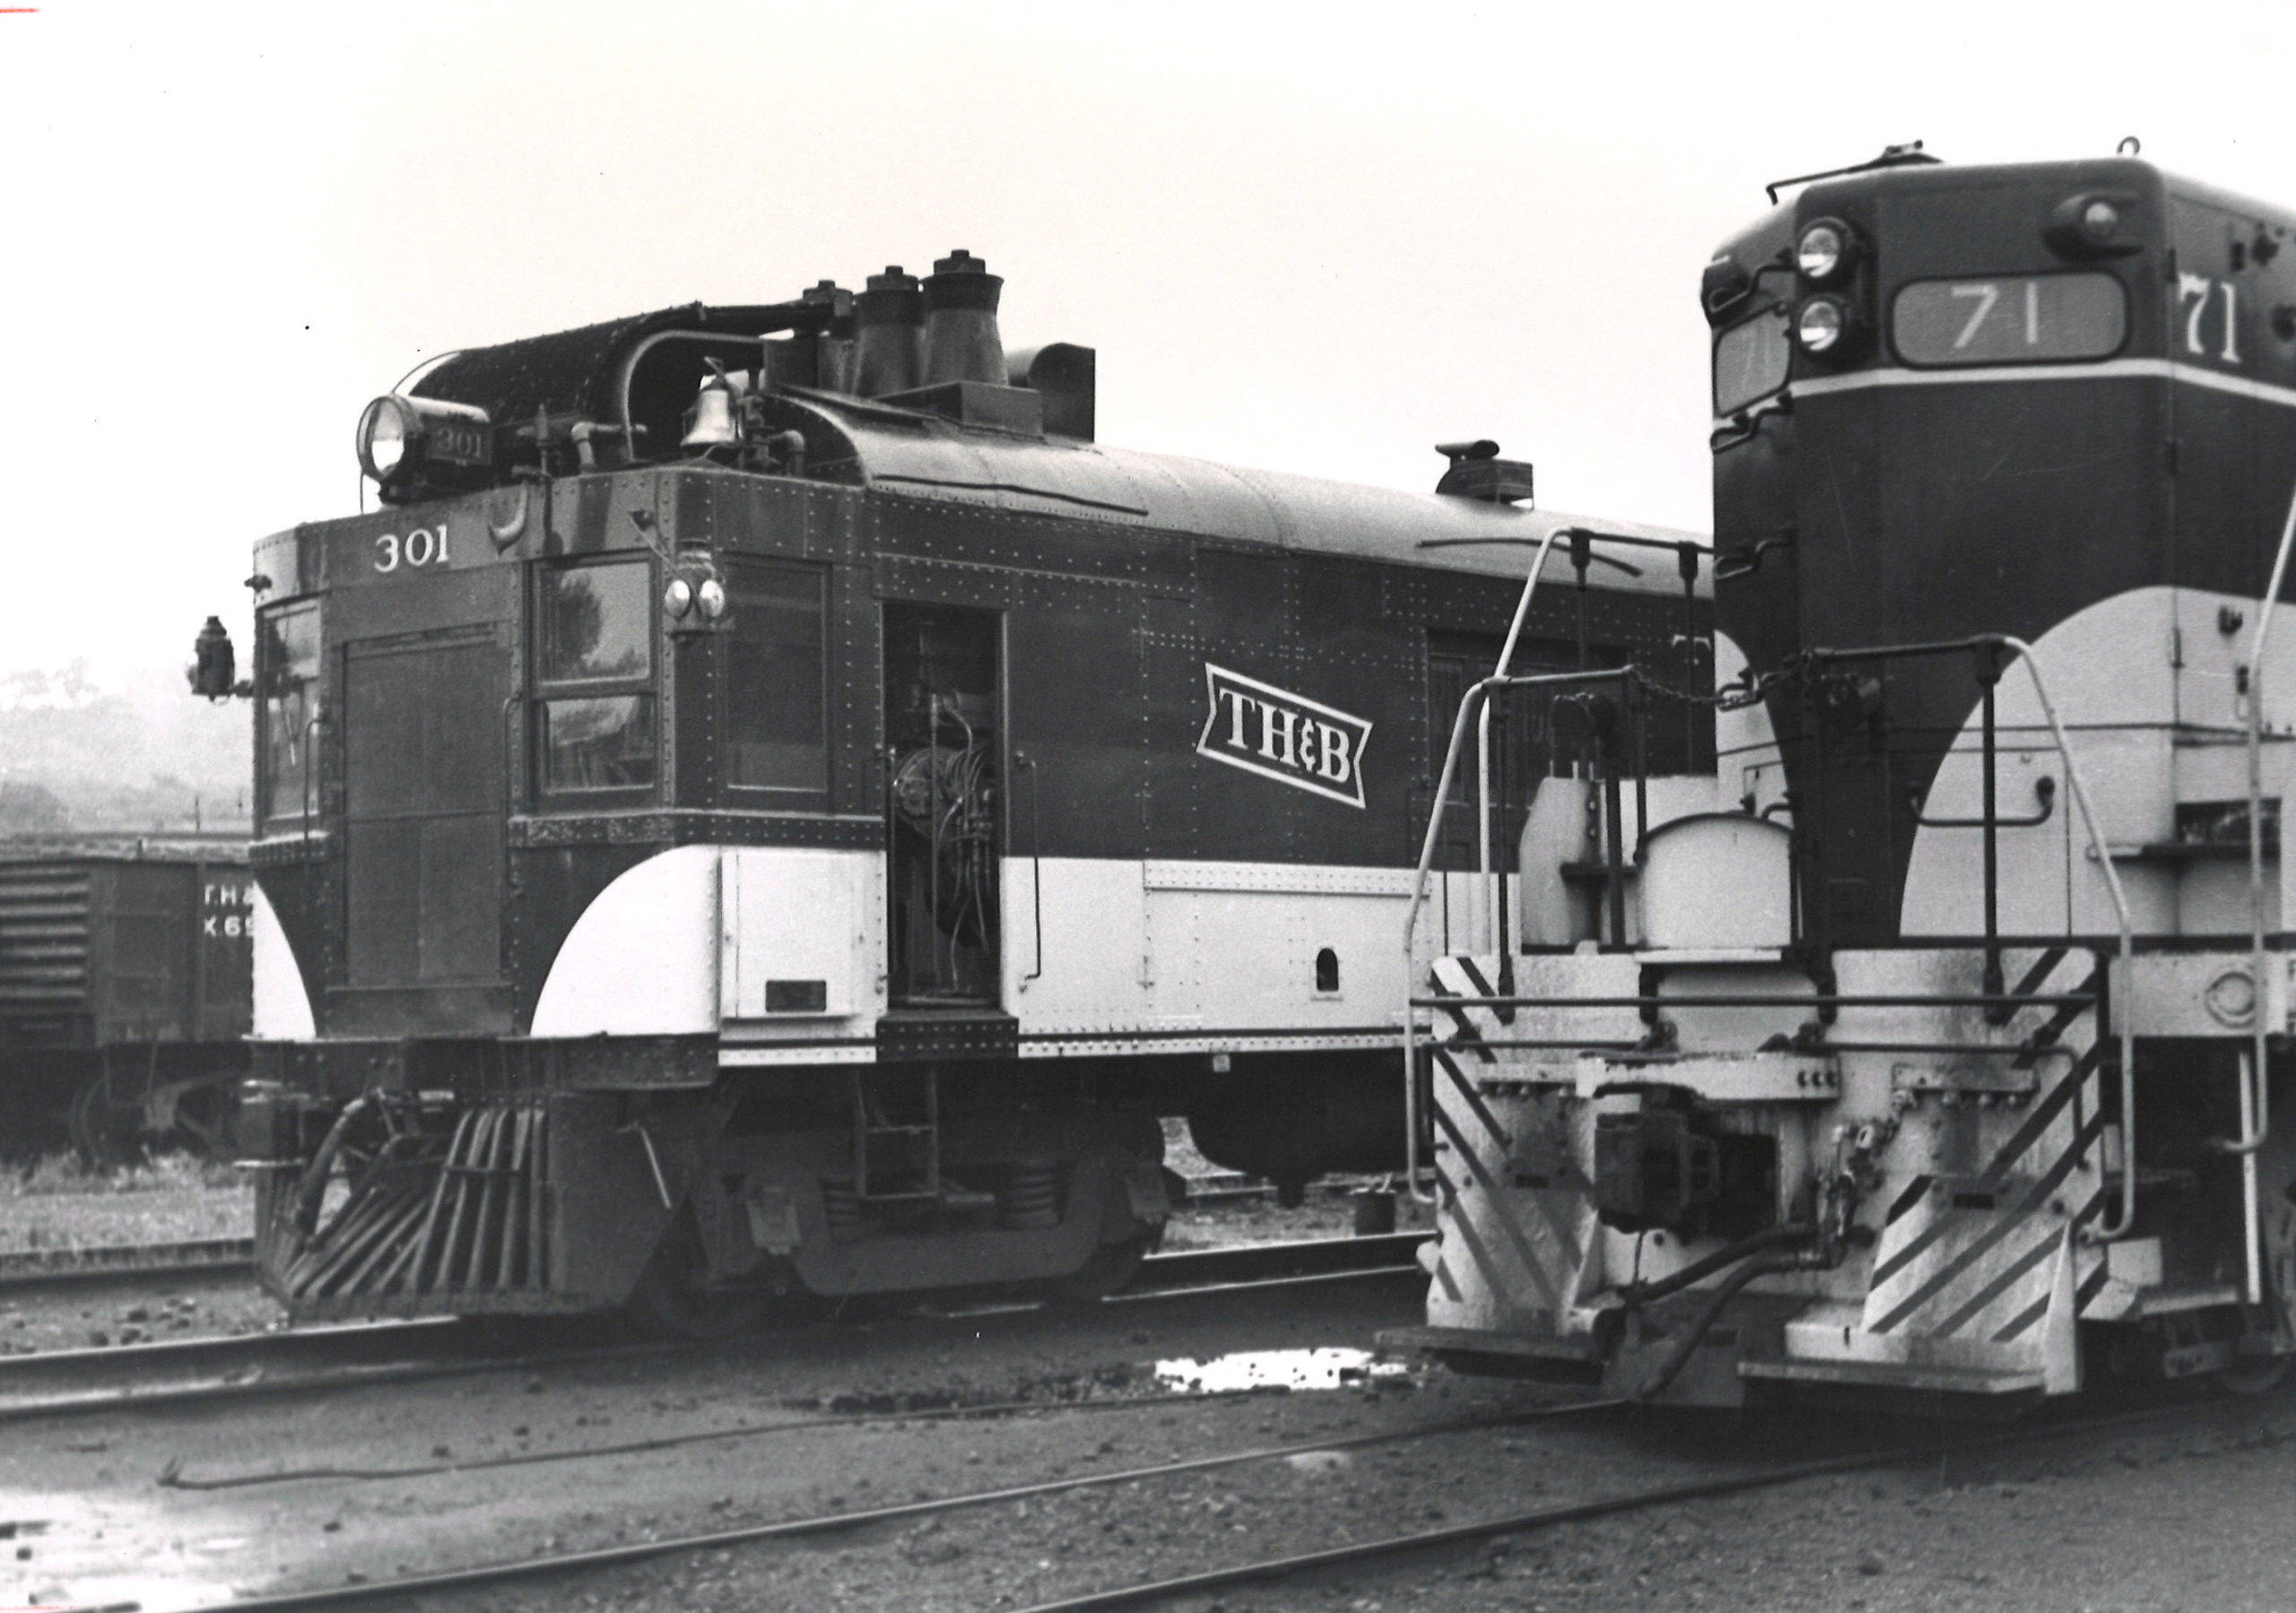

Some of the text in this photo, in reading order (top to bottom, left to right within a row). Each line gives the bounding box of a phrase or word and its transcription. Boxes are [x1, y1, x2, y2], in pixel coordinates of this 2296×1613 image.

[1950, 282, 2039, 348] 71
[2179, 272, 2243, 364] 71
[438, 426, 483, 457] 301
[374, 525, 450, 573] 301
[1218, 687, 1351, 784] TH&B
